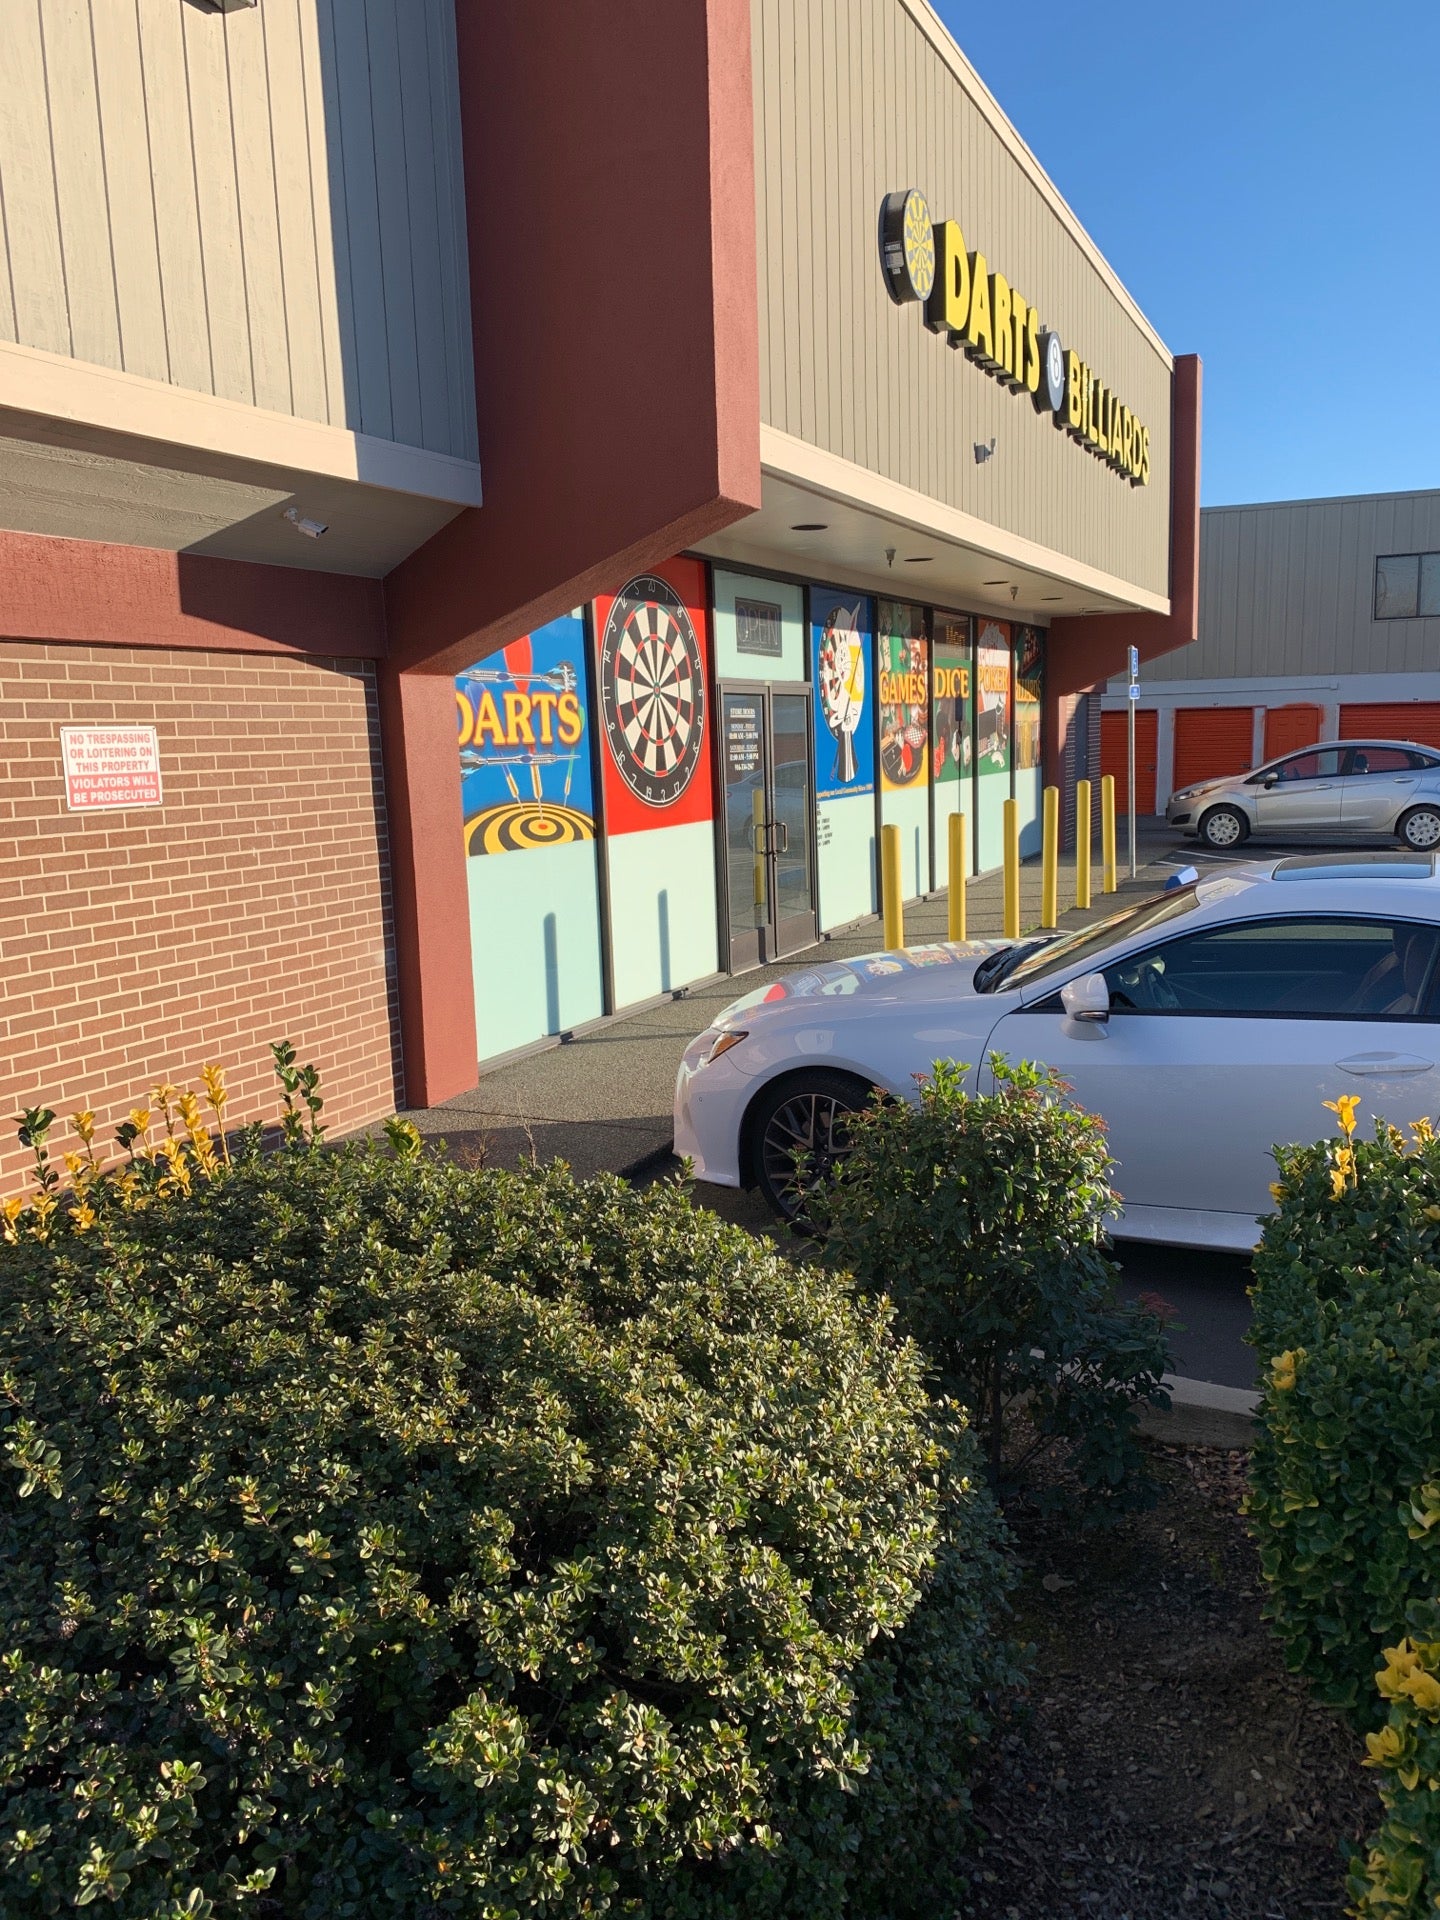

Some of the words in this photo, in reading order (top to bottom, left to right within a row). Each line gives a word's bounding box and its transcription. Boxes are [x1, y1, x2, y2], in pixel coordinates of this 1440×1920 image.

[945, 219, 1041, 393] DARTS
[1069, 350, 1149, 486] BILLIARDS
[736, 605, 778, 646] OPEN
[880, 671, 927, 705] GAMES
[934, 668, 970, 699] DICE
[978, 665, 1008, 693] POKER
[69, 734, 84, 745] NO
[87, 733, 151, 744] TRESPASSING
[70, 749, 84, 759] OR
[87, 747, 137, 758] LOITERING
[139, 746, 152, 757] ON
[76, 762, 99, 773] THIS
[102, 760, 149, 772] PROPERTY
[72, 778, 130, 790] VIOLATORS
[132, 776, 156, 787] WILL
[73, 792, 88, 803] BE
[90, 789, 157, 803] PROSECUTED
